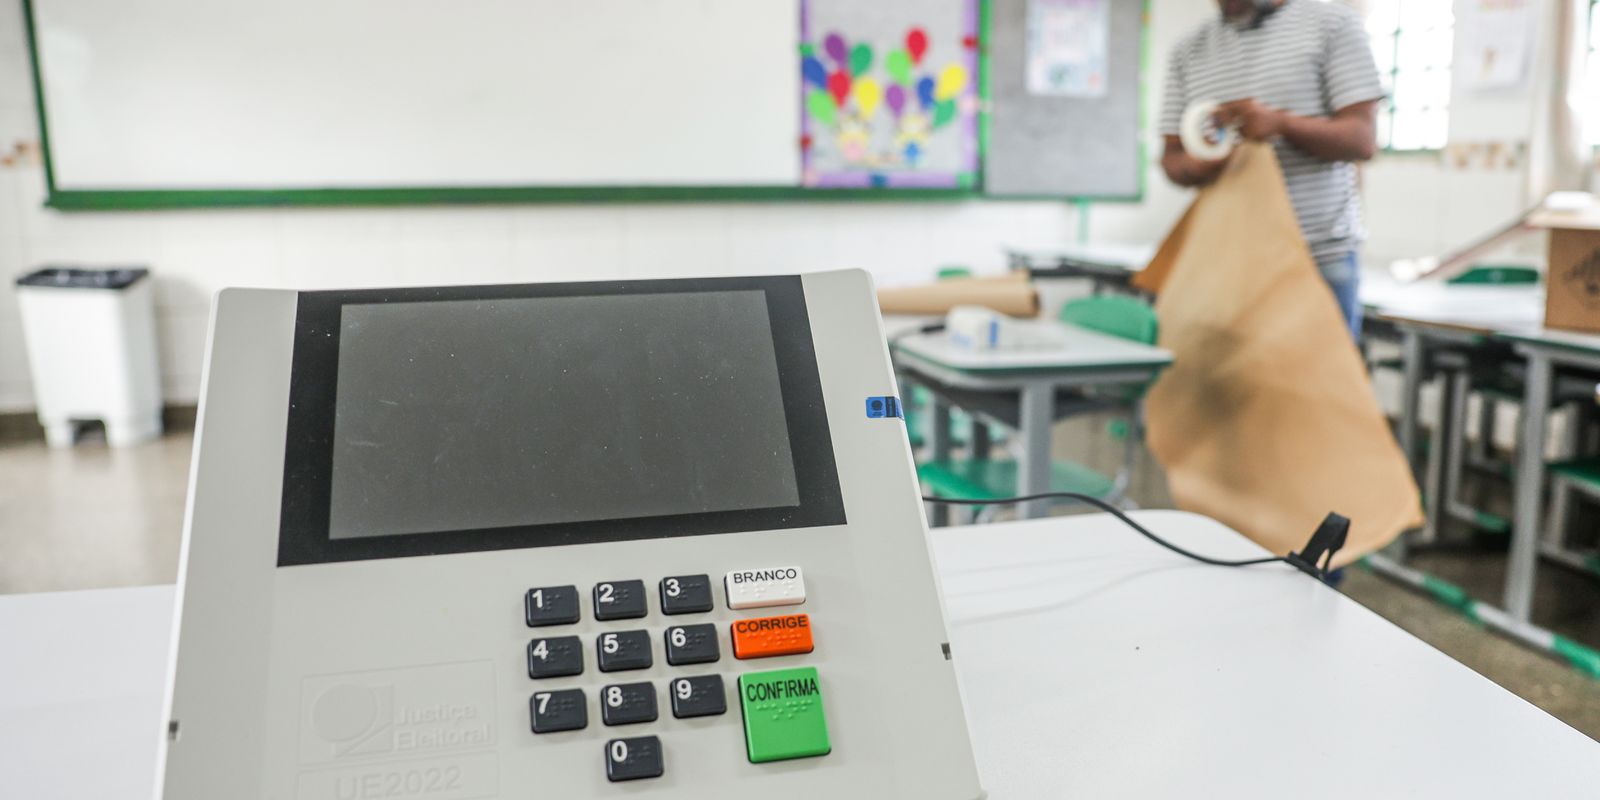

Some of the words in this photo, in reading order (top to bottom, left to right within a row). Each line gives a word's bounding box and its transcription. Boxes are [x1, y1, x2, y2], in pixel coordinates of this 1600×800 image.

[733, 567, 798, 584] BRANCO
[599, 584, 614, 603] 2
[666, 578, 681, 597] 3
[532, 589, 544, 608] 1
[736, 615, 809, 635] CORRIGE
[603, 634, 619, 653] 5
[671, 628, 686, 647] 6
[532, 640, 549, 660] 4
[607, 686, 623, 707] 8
[676, 680, 692, 699] 9
[746, 677, 820, 703] CONFIRMA
[536, 693, 551, 714] 7
[394, 723, 491, 751] Eleitoral
[611, 740, 628, 763] 0
[336, 765, 463, 800] UE2022
